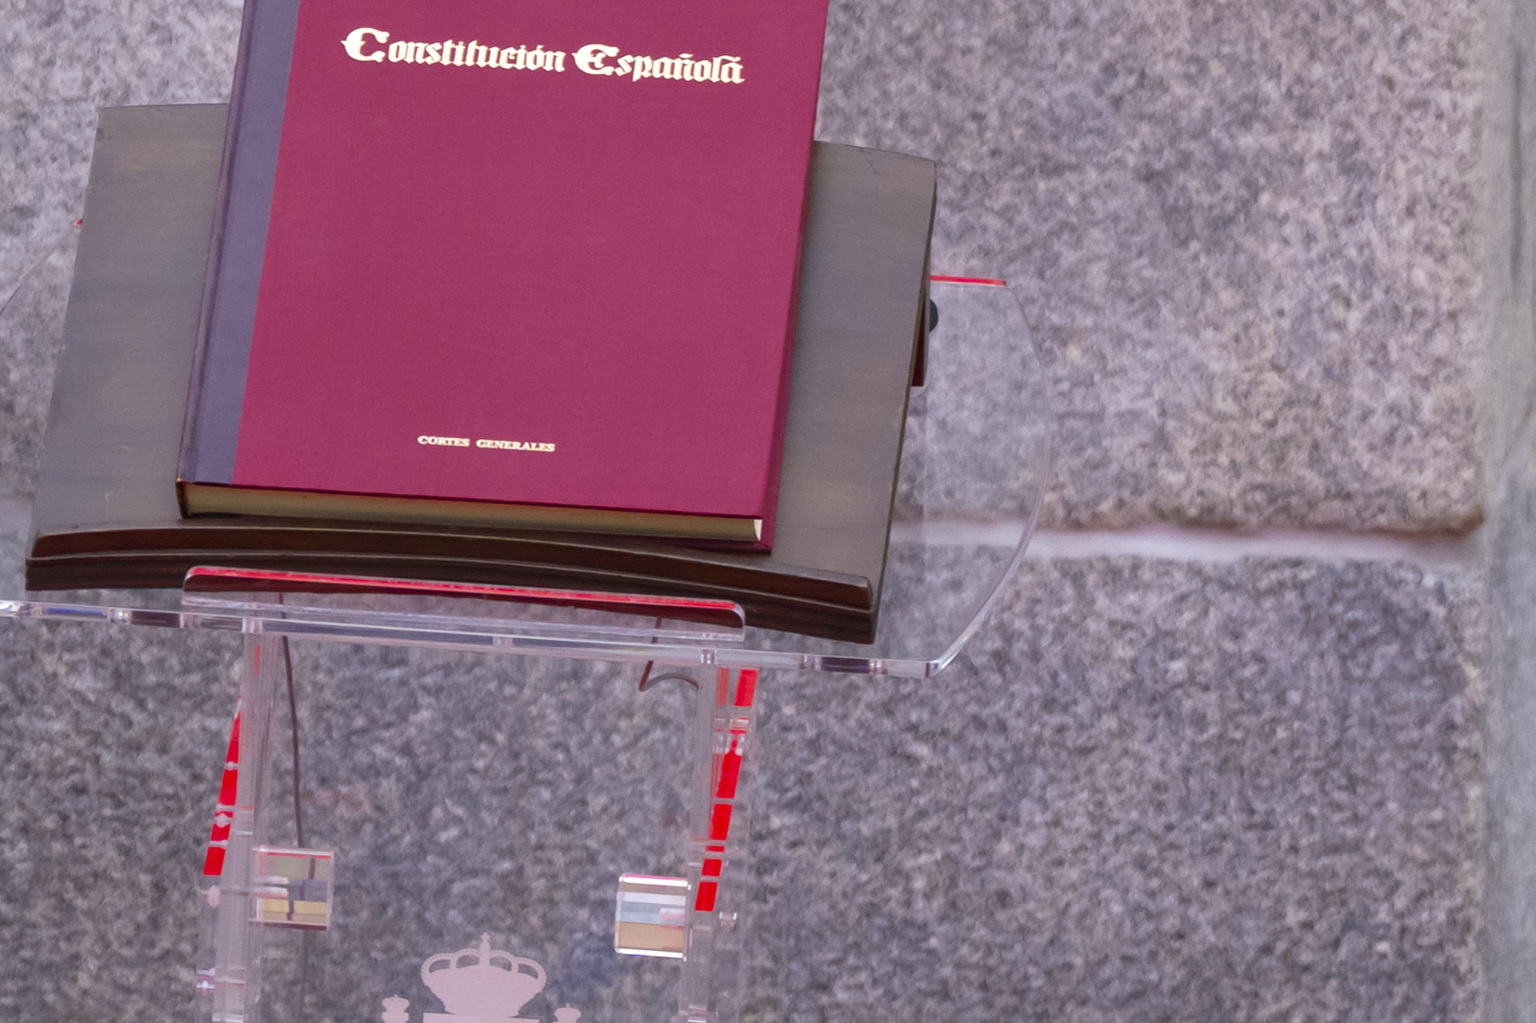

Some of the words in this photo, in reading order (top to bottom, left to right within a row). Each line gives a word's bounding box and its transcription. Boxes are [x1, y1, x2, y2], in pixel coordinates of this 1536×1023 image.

[340, 26, 566, 73] Constitución
[571, 43, 745, 84] Española
[417, 435, 470, 447] CORTES
[476, 439, 556, 452] GENERALES
